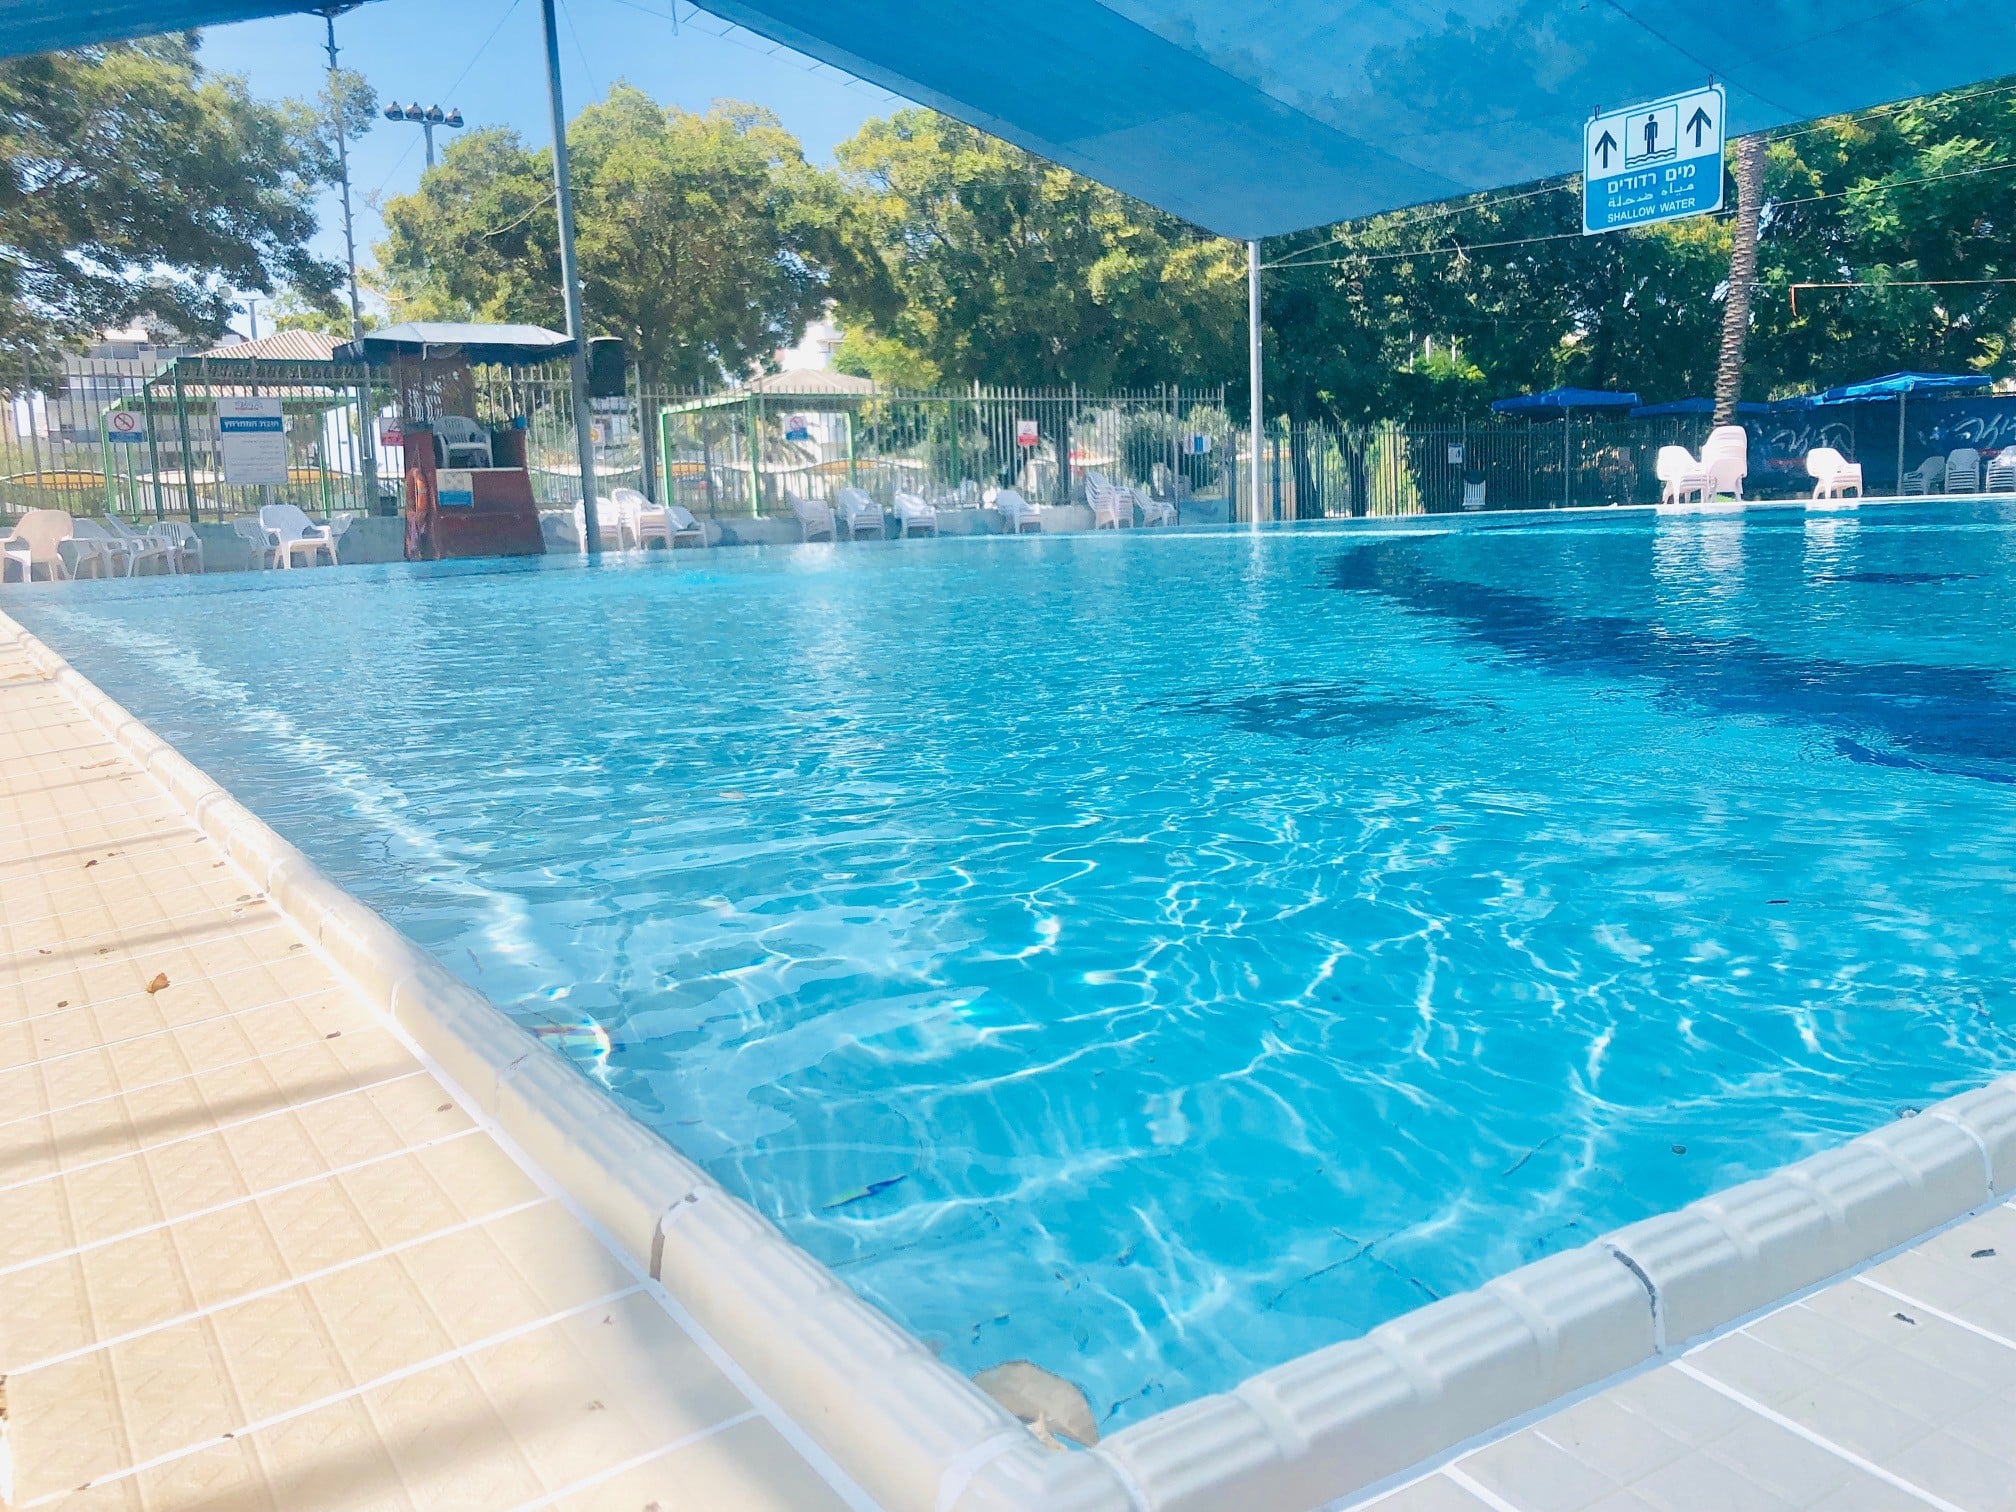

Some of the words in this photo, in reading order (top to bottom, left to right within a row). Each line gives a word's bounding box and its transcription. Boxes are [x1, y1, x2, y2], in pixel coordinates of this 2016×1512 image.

[1665, 164, 1696, 182] מים
[1607, 172, 1657, 194] רדודים
[1661, 182, 1695, 196] مياه
[1608, 192, 1654, 208] ضحلة
[1607, 204, 1656, 223] SHALLOW
[1660, 197, 1696, 213] WATER
